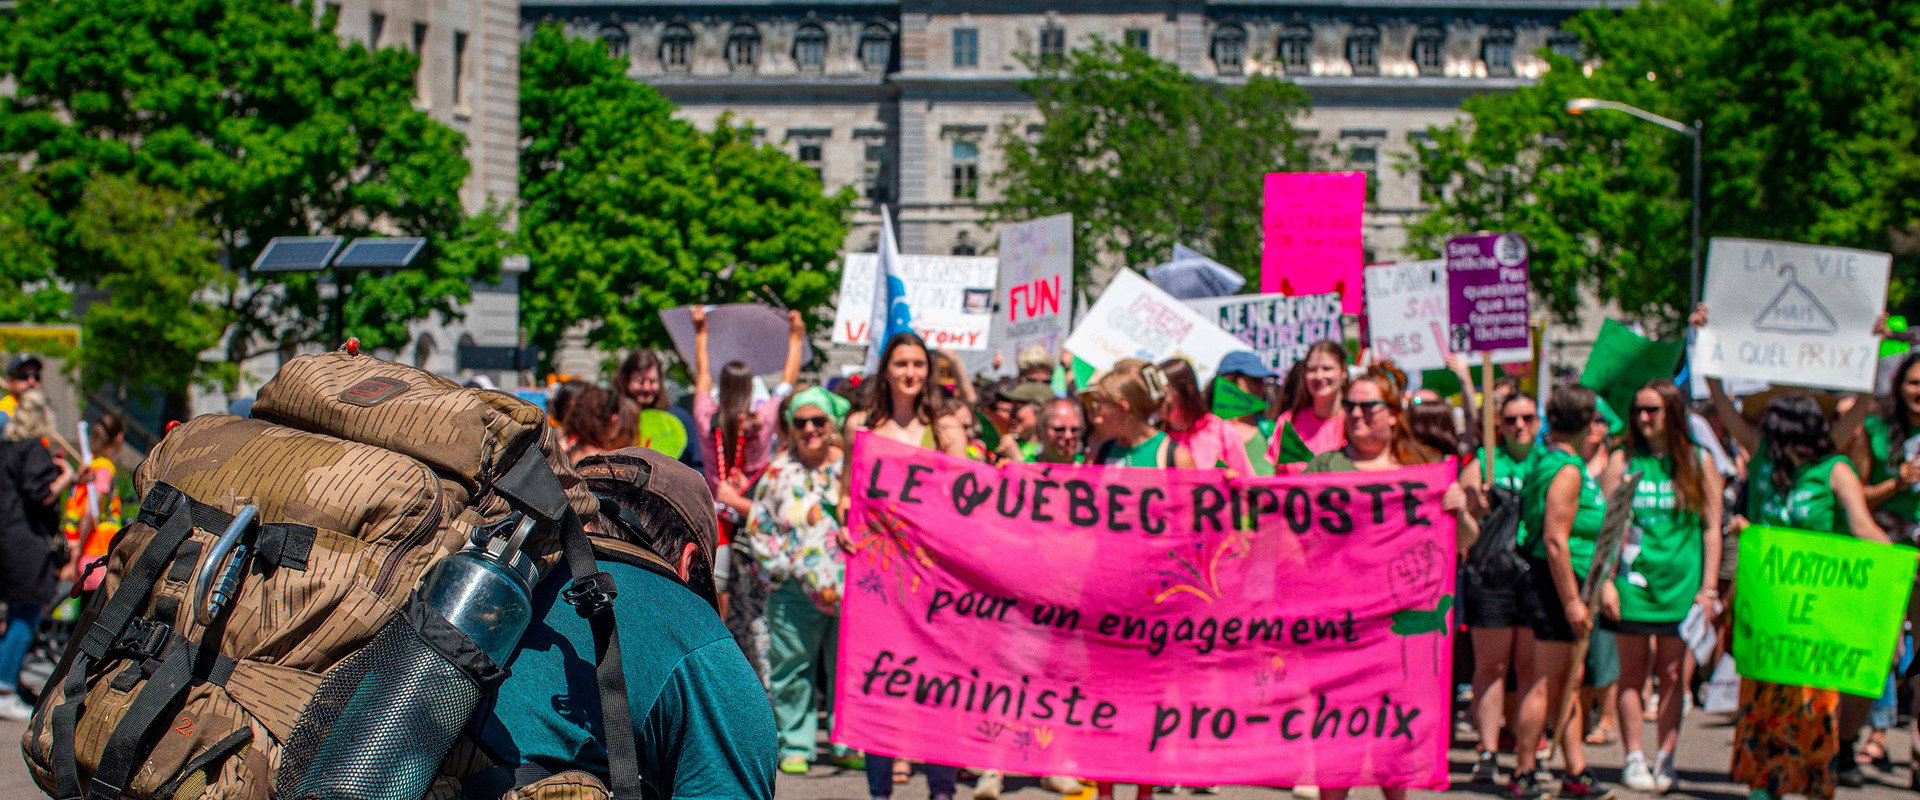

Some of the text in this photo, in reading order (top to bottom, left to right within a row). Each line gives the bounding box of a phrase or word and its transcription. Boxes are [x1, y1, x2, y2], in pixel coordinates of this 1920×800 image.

[1448, 242, 1481, 258] Sans
[1743, 246, 1859, 282] LA VIE
[1370, 263, 1445, 298] L'AVO
[1500, 266, 1527, 283] Pas
[1463, 282, 1527, 302] question
[1475, 296, 1527, 315] que les
[1403, 297, 1444, 320] SA
[844, 319, 981, 347] VTOMY
[1738, 340, 1790, 368] QUEL
[866, 459, 1433, 536] LE QUÉBEC RIPOSTE
[1756, 544, 1875, 590] AVORTONS
[926, 588, 1362, 657] pour un engagement
[1786, 592, 1819, 626] LE
[861, 650, 1422, 753] féministe pro-choix
